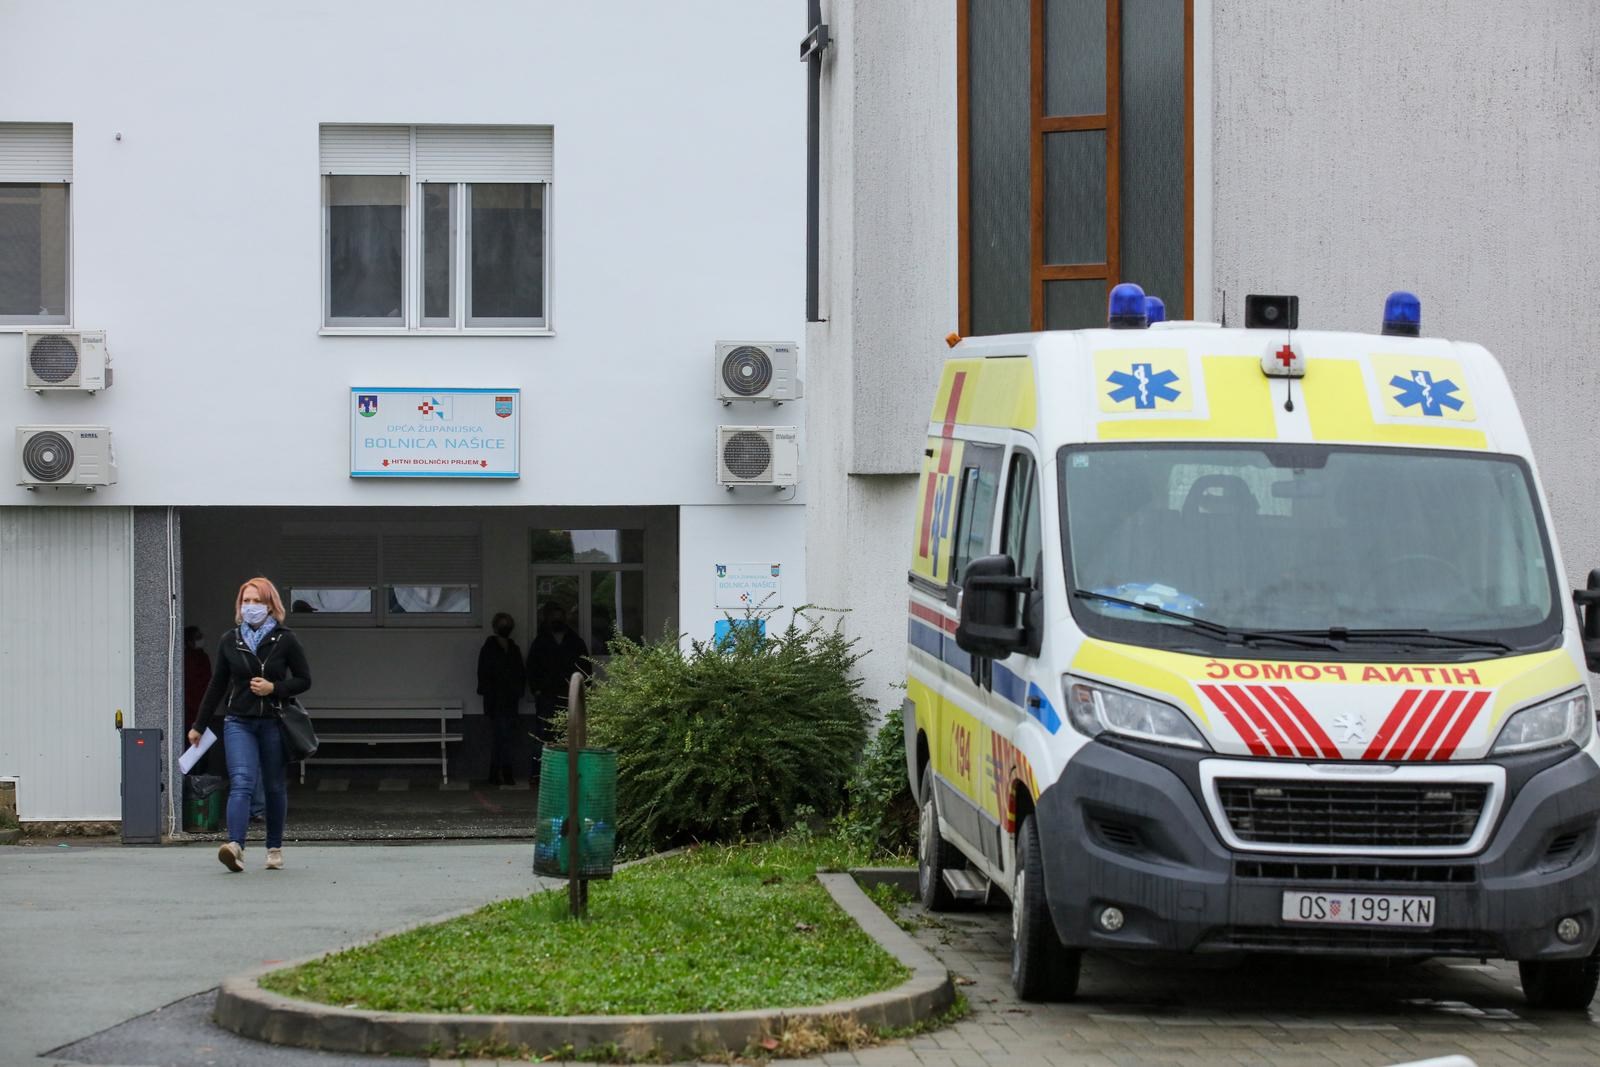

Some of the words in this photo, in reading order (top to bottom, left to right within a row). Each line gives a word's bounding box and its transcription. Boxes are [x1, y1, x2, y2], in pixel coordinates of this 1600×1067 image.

[387, 423, 416, 433] OPĆA
[418, 423, 484, 433] ŽUPANIJSKA
[364, 437, 438, 449] BOLNICA
[445, 436, 505, 449] NAŠICE
[1300, 895, 1327, 920] OS
[1350, 897, 1431, 923] 199-KN
